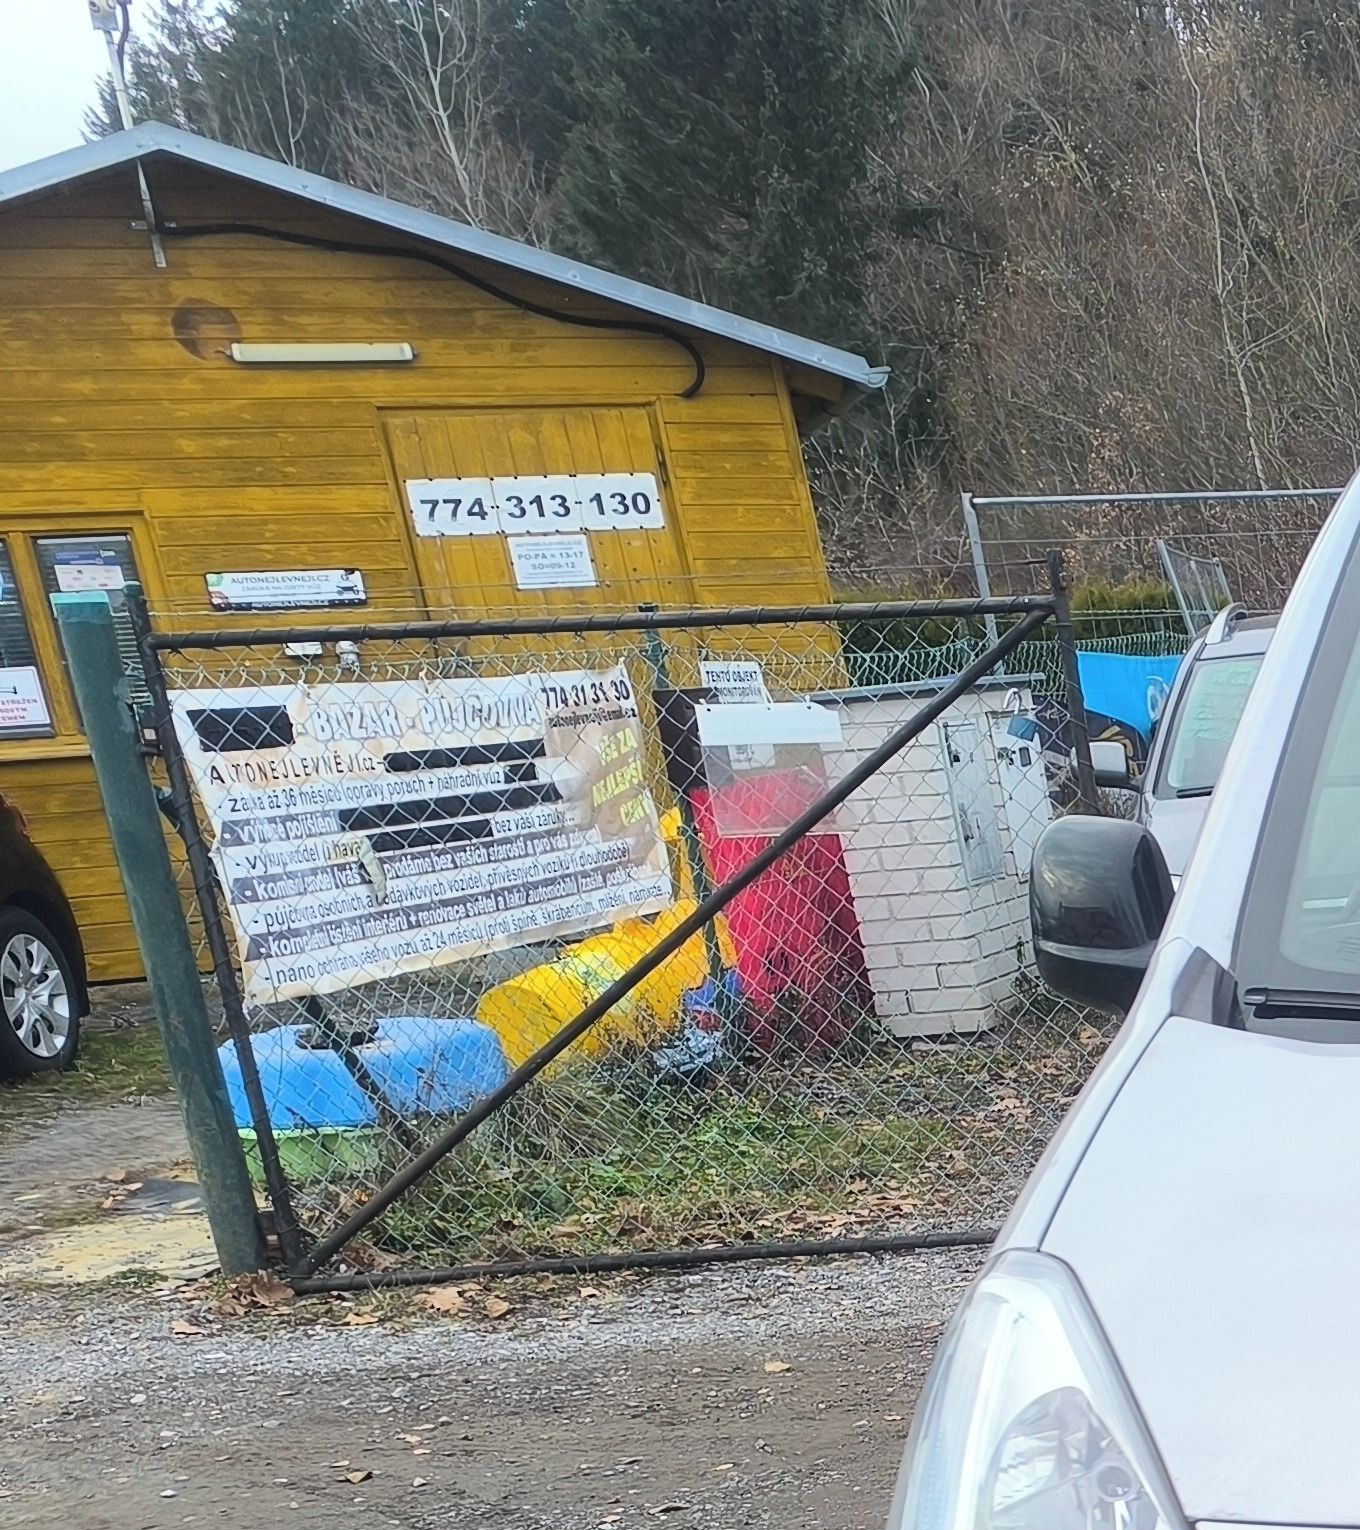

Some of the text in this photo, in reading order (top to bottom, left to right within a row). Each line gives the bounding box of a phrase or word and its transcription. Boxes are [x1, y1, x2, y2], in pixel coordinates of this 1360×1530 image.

[419, 491, 651, 522] 774-313-130
[541, 686, 569, 709] 774
[611, 679, 631, 701] 30
[309, 701, 402, 741] BAZAR
[282, 788, 297, 807] 36
